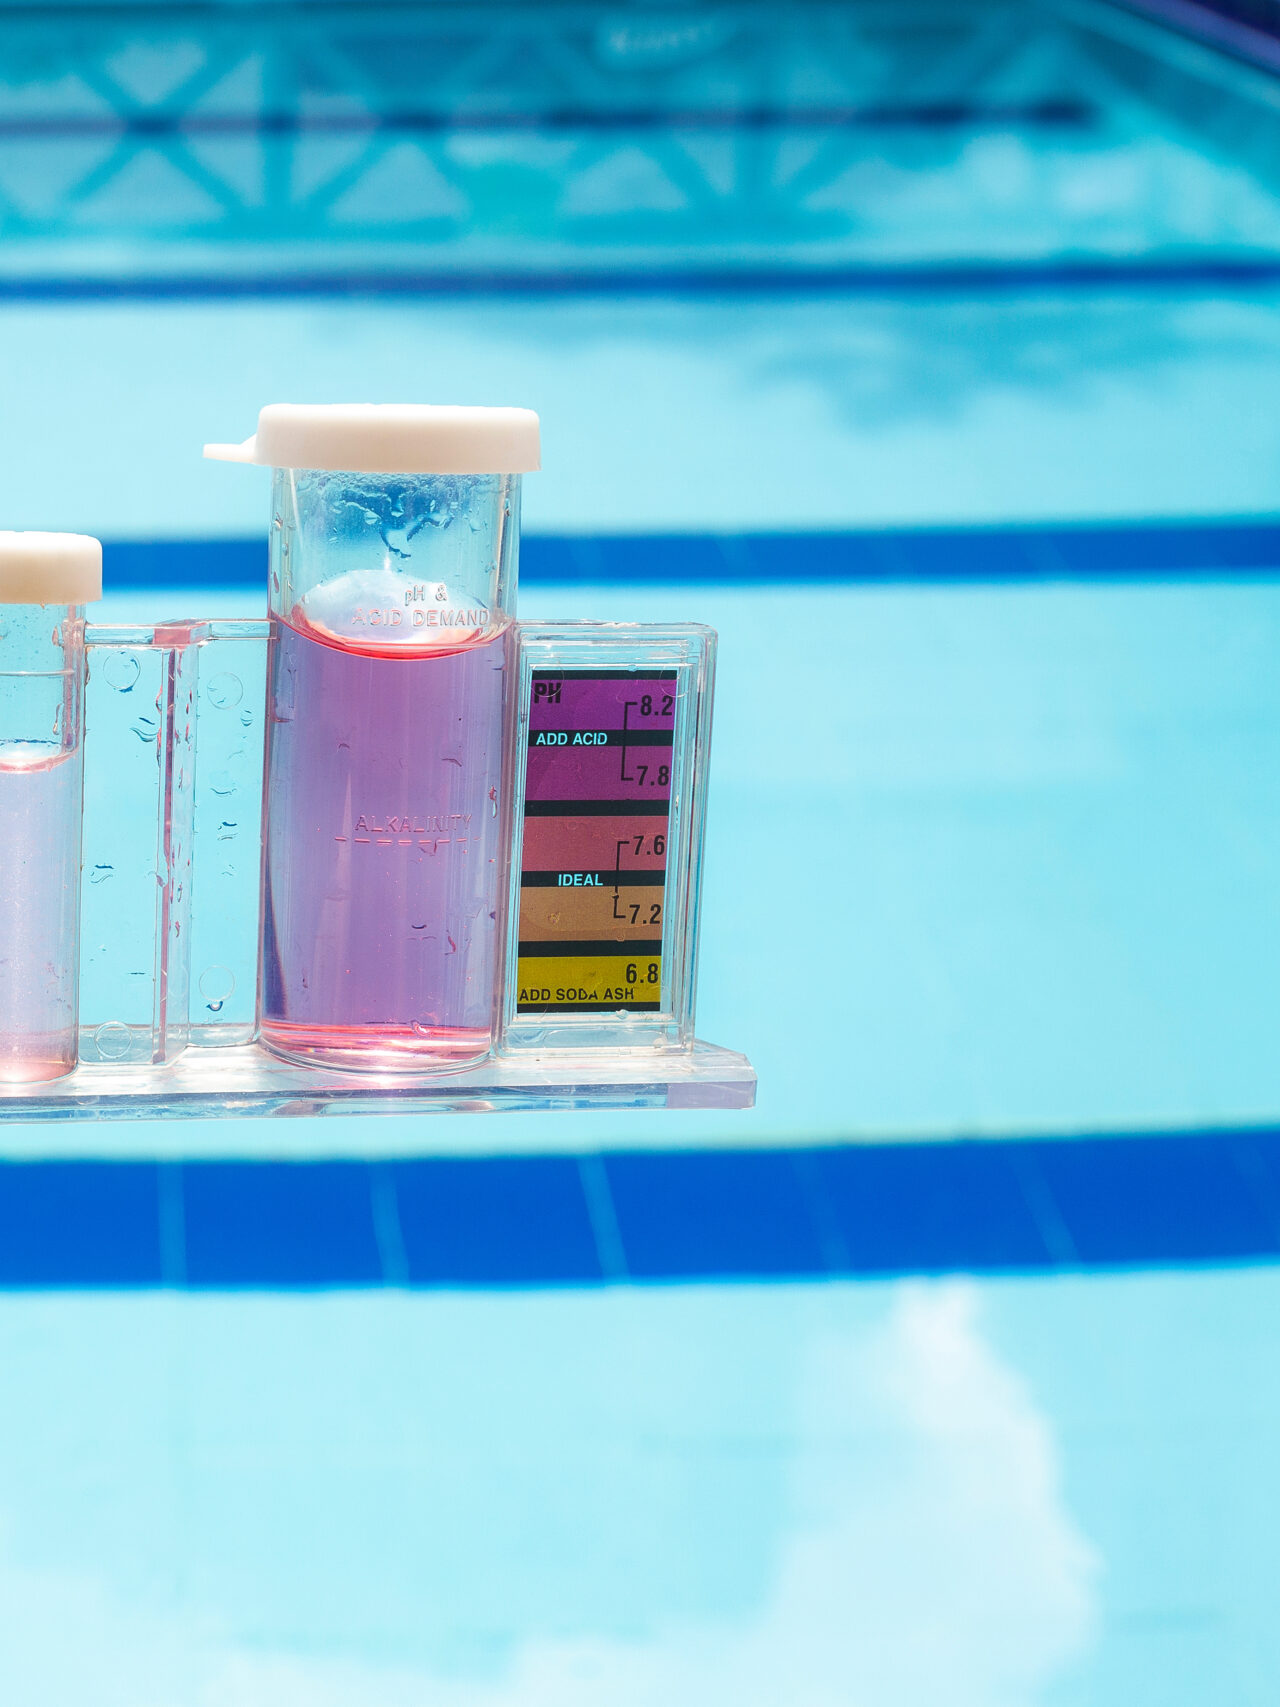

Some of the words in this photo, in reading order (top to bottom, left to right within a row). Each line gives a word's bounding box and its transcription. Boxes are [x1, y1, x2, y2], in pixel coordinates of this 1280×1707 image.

[404, 584, 425, 606] pH
[435, 584, 448, 601] &
[352, 608, 402, 626] ACID
[412, 608, 490, 627] DEMAND
[533, 682, 562, 704] PH
[640, 695, 674, 716] 8.2
[535, 732, 568, 746] ADD
[572, 732, 608, 746] ACID
[636, 765, 670, 786] 7.8
[354, 814, 473, 833] ALKALINITY
[633, 834, 665, 856] 7.6
[557, 873, 604, 887] IDEAL
[629, 903, 662, 925] 7.2
[625, 963, 659, 984] 6.8
[520, 988, 551, 1001] ADD
[556, 987, 598, 1001] SODA
[603, 987, 634, 1000] ASH
